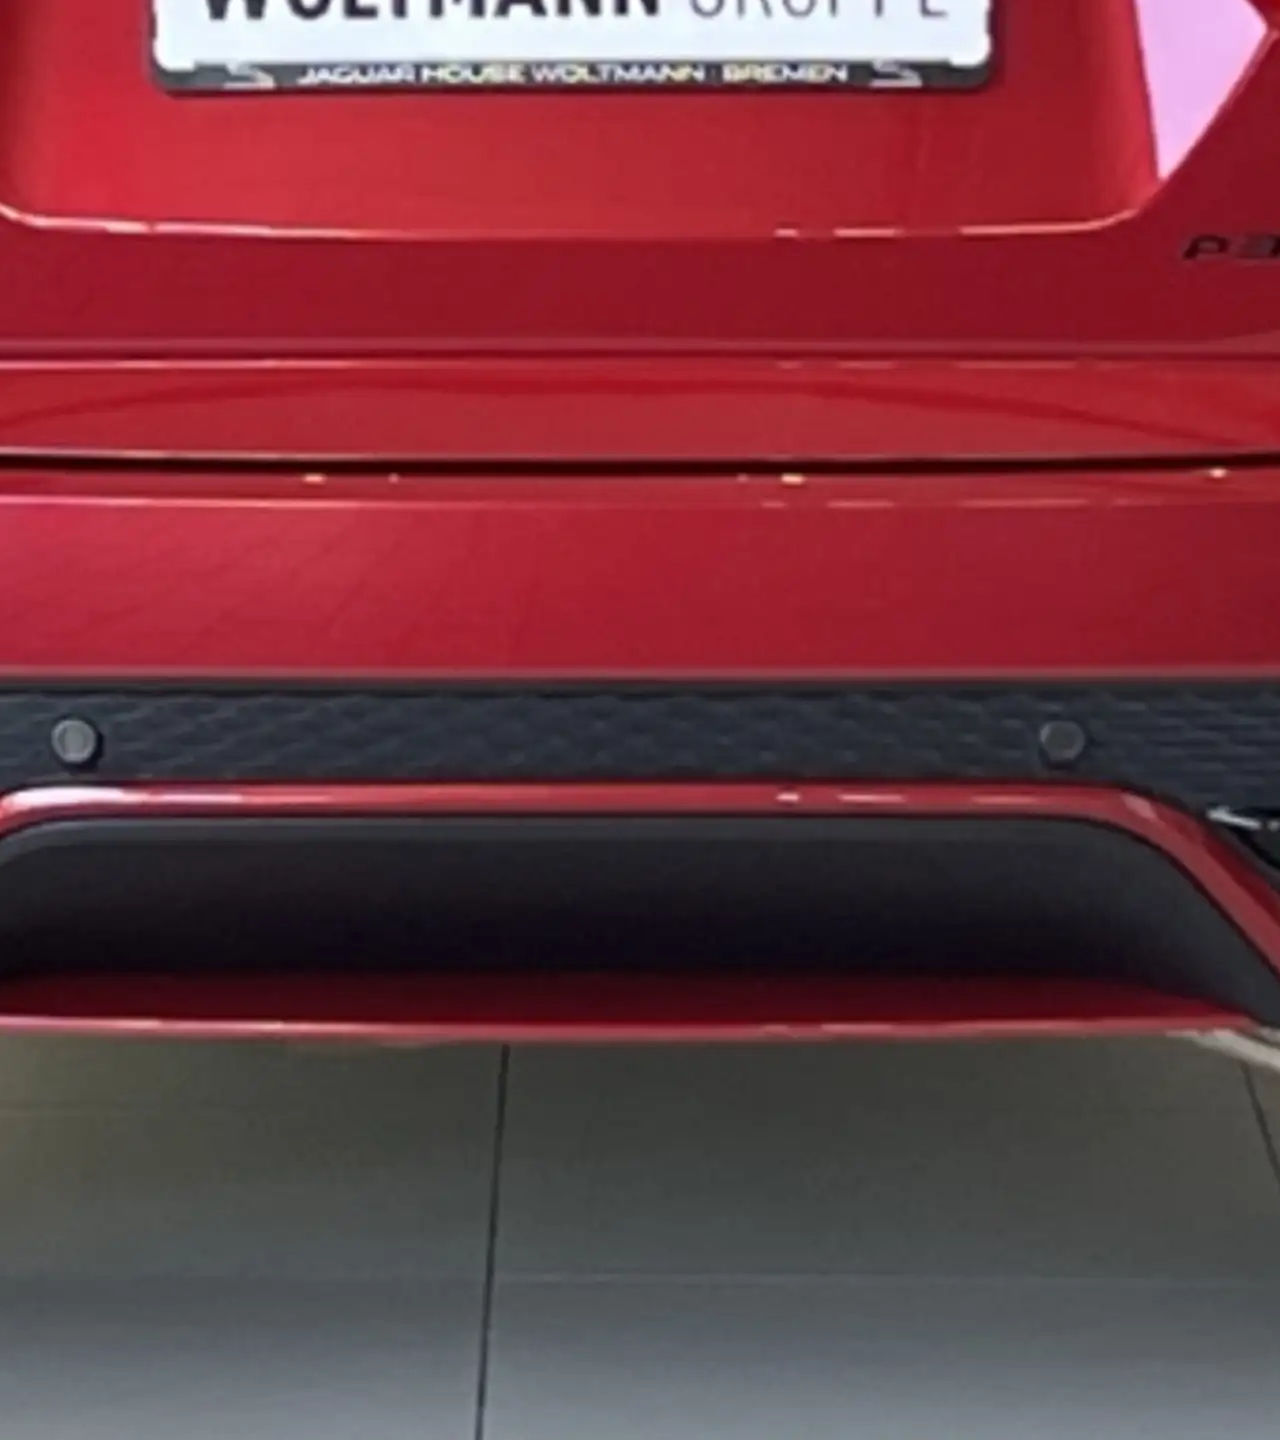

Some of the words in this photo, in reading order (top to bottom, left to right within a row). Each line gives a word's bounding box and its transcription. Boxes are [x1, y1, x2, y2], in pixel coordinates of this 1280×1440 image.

[297, 64, 417, 85] JAGUAR
[421, 63, 524, 85] HOUSE
[530, 63, 706, 84] WOLTMANN
[721, 63, 850, 84] BREMEN
